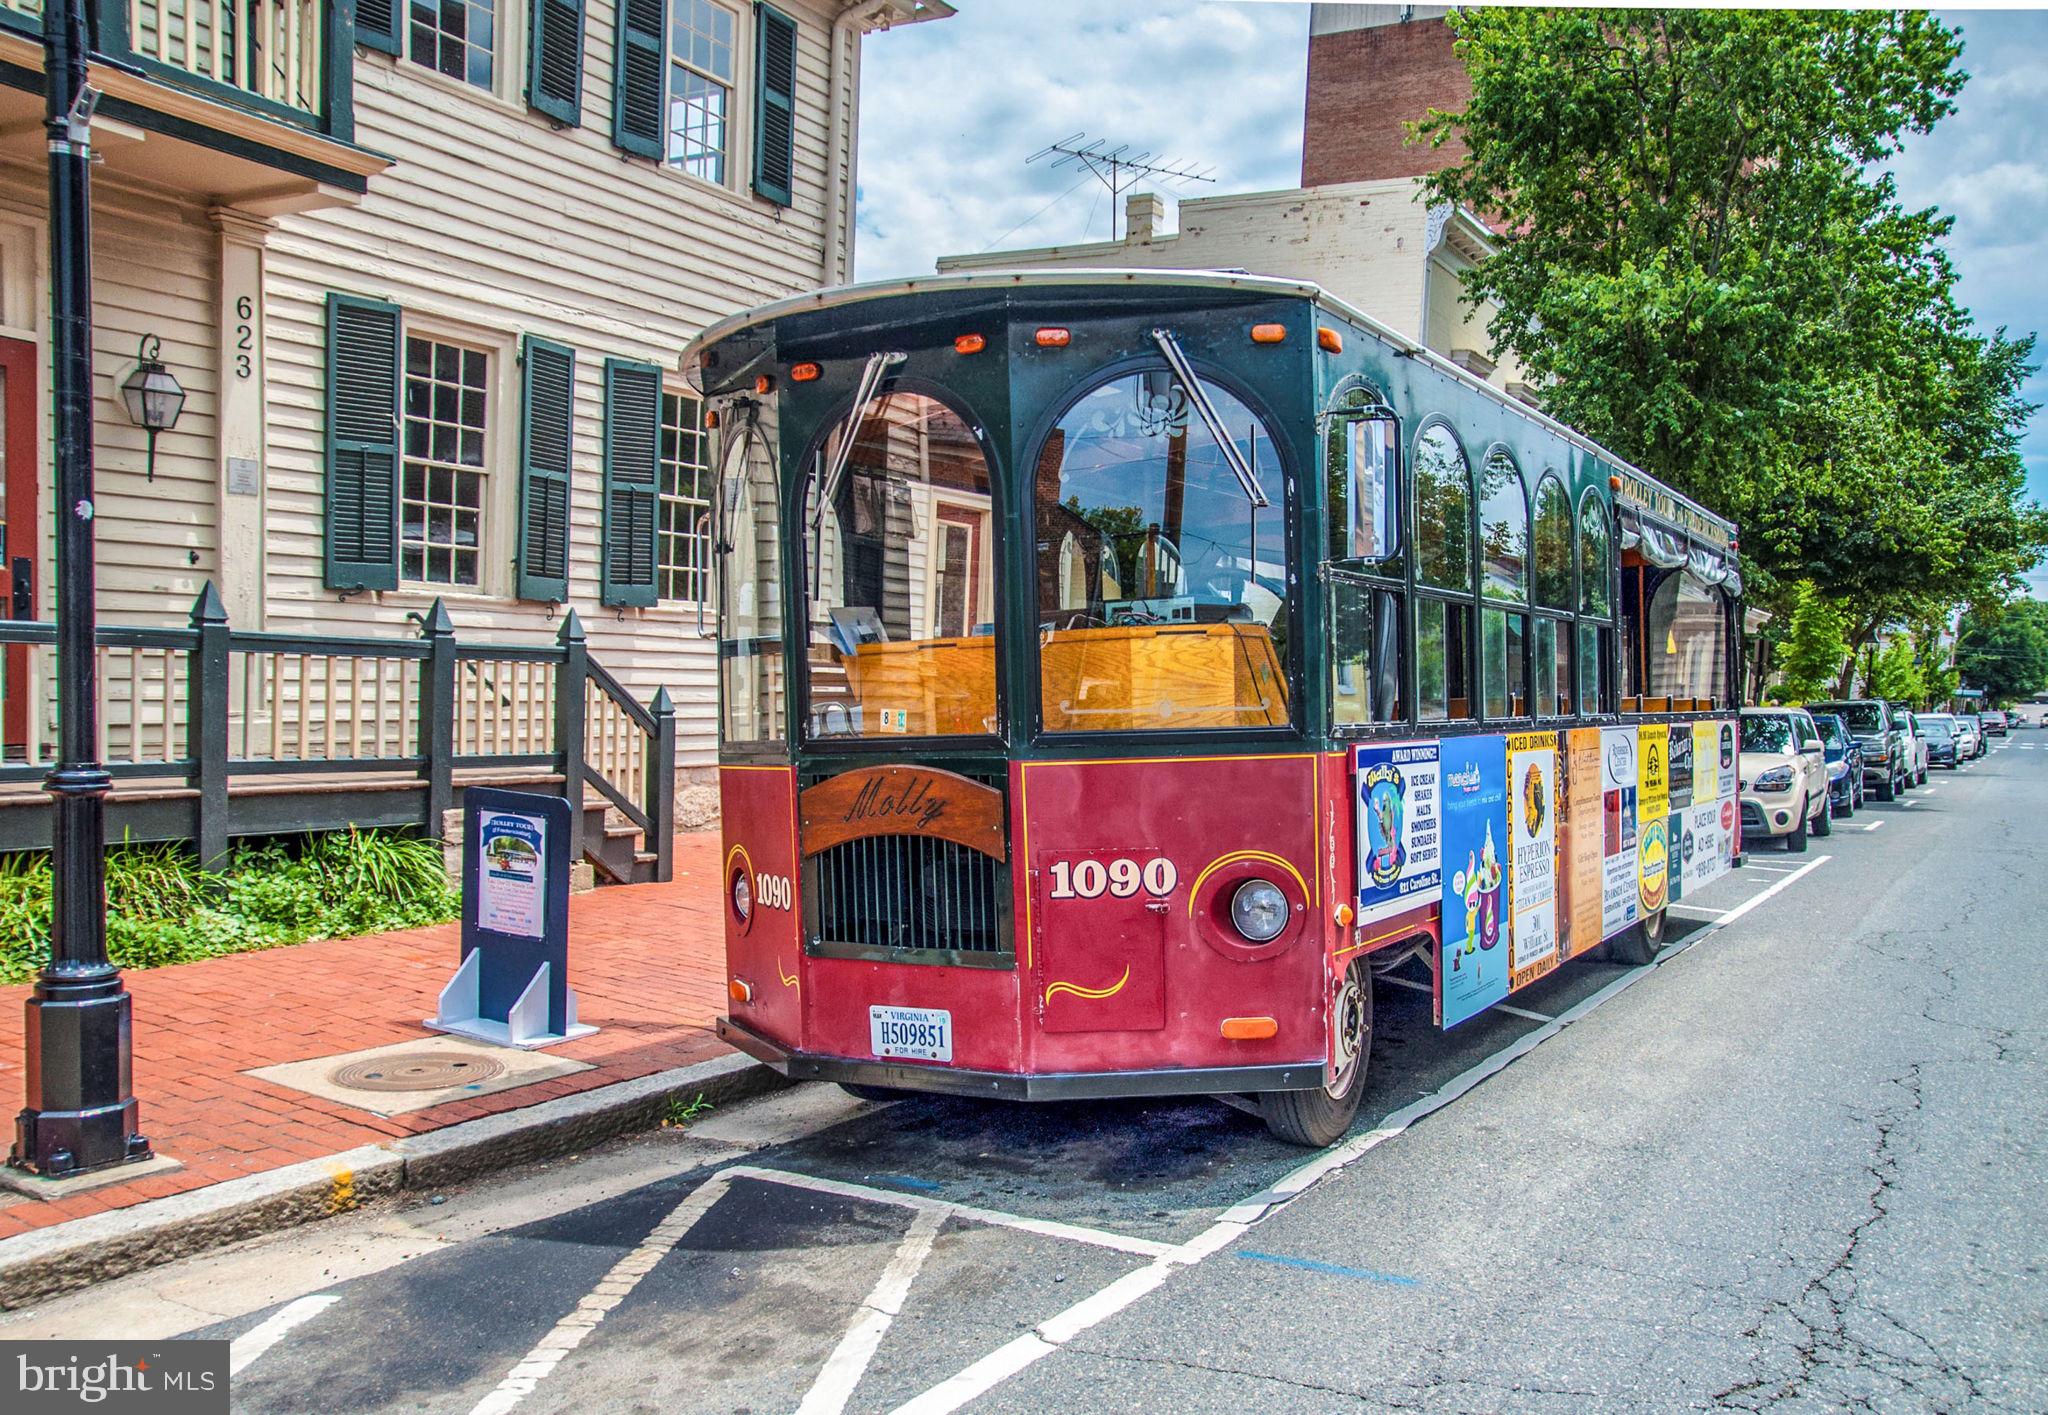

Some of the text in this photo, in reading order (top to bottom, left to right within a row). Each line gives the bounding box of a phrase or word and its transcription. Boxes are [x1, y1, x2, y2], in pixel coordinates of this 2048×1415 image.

[236, 295, 253, 379] 623
[1619, 473, 1652, 511] TROLLEY
[1511, 734, 1554, 751] ICED DRINKS
[1367, 765, 1400, 788] Wally's
[1411, 773, 1435, 786] ICE CREAM
[843, 776, 947, 830] Molly
[1414, 788, 1432, 802] SHAKES
[1416, 803, 1431, 817] MALTS
[491, 819, 515, 828] TROLLEY
[1411, 817, 1437, 833] SMOOTHIES
[1694, 811, 1706, 829] PLACE
[1411, 834, 1432, 849] SUNDAES
[1410, 850, 1422, 864] SOFT
[1517, 839, 1551, 865] HYPERION
[1049, 857, 1179, 899] 1090
[1519, 858, 1550, 884] ESPRESSO
[1409, 874, 1431, 889] Caroline
[756, 872, 792, 912] 1090
[1516, 955, 1554, 987] OPEN DAILY
[890, 1011, 929, 1022] VIRGINIA
[881, 1021, 945, 1048] H509851
[895, 1046, 927, 1056] FOR HIRE
